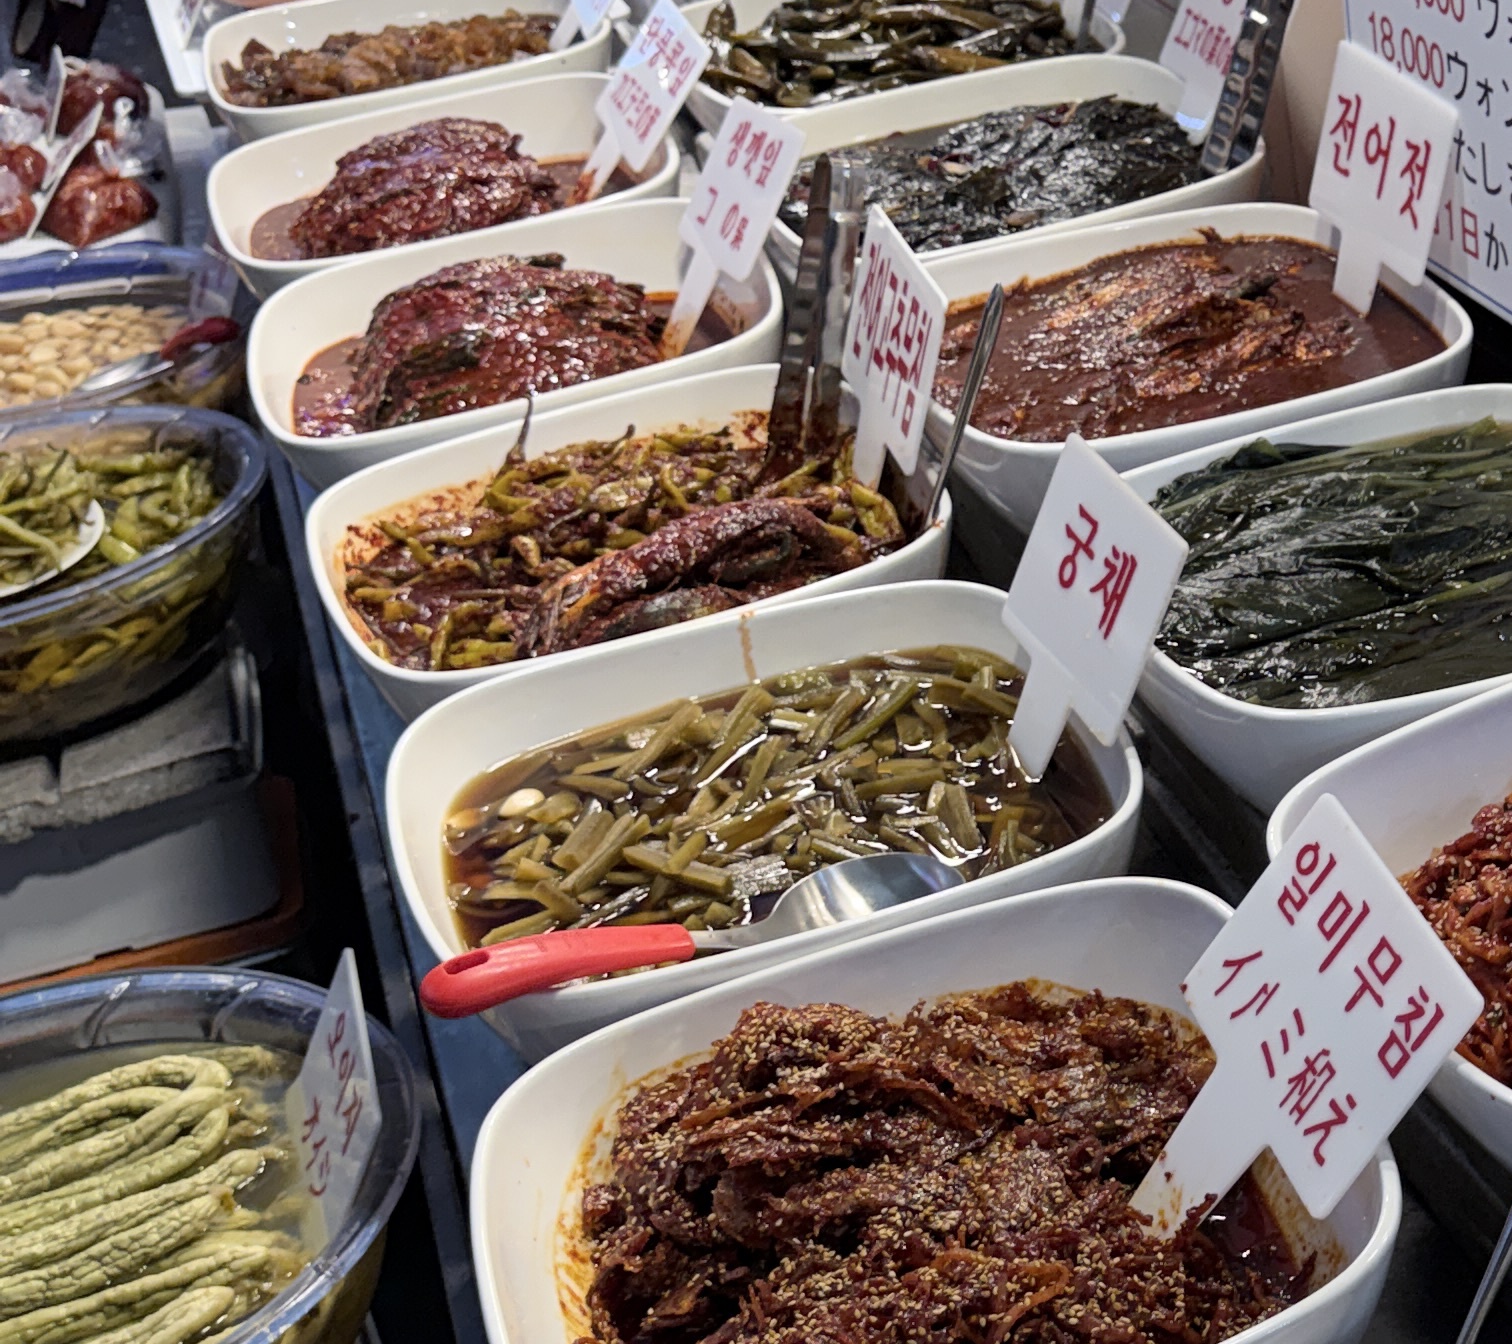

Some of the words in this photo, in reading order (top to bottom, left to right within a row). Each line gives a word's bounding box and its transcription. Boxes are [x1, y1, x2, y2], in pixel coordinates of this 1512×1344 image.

[1057, 503, 1139, 641] 궁채
[1277, 841, 1445, 1081] 일미무침
[328, 1010, 363, 1157] 오이지
